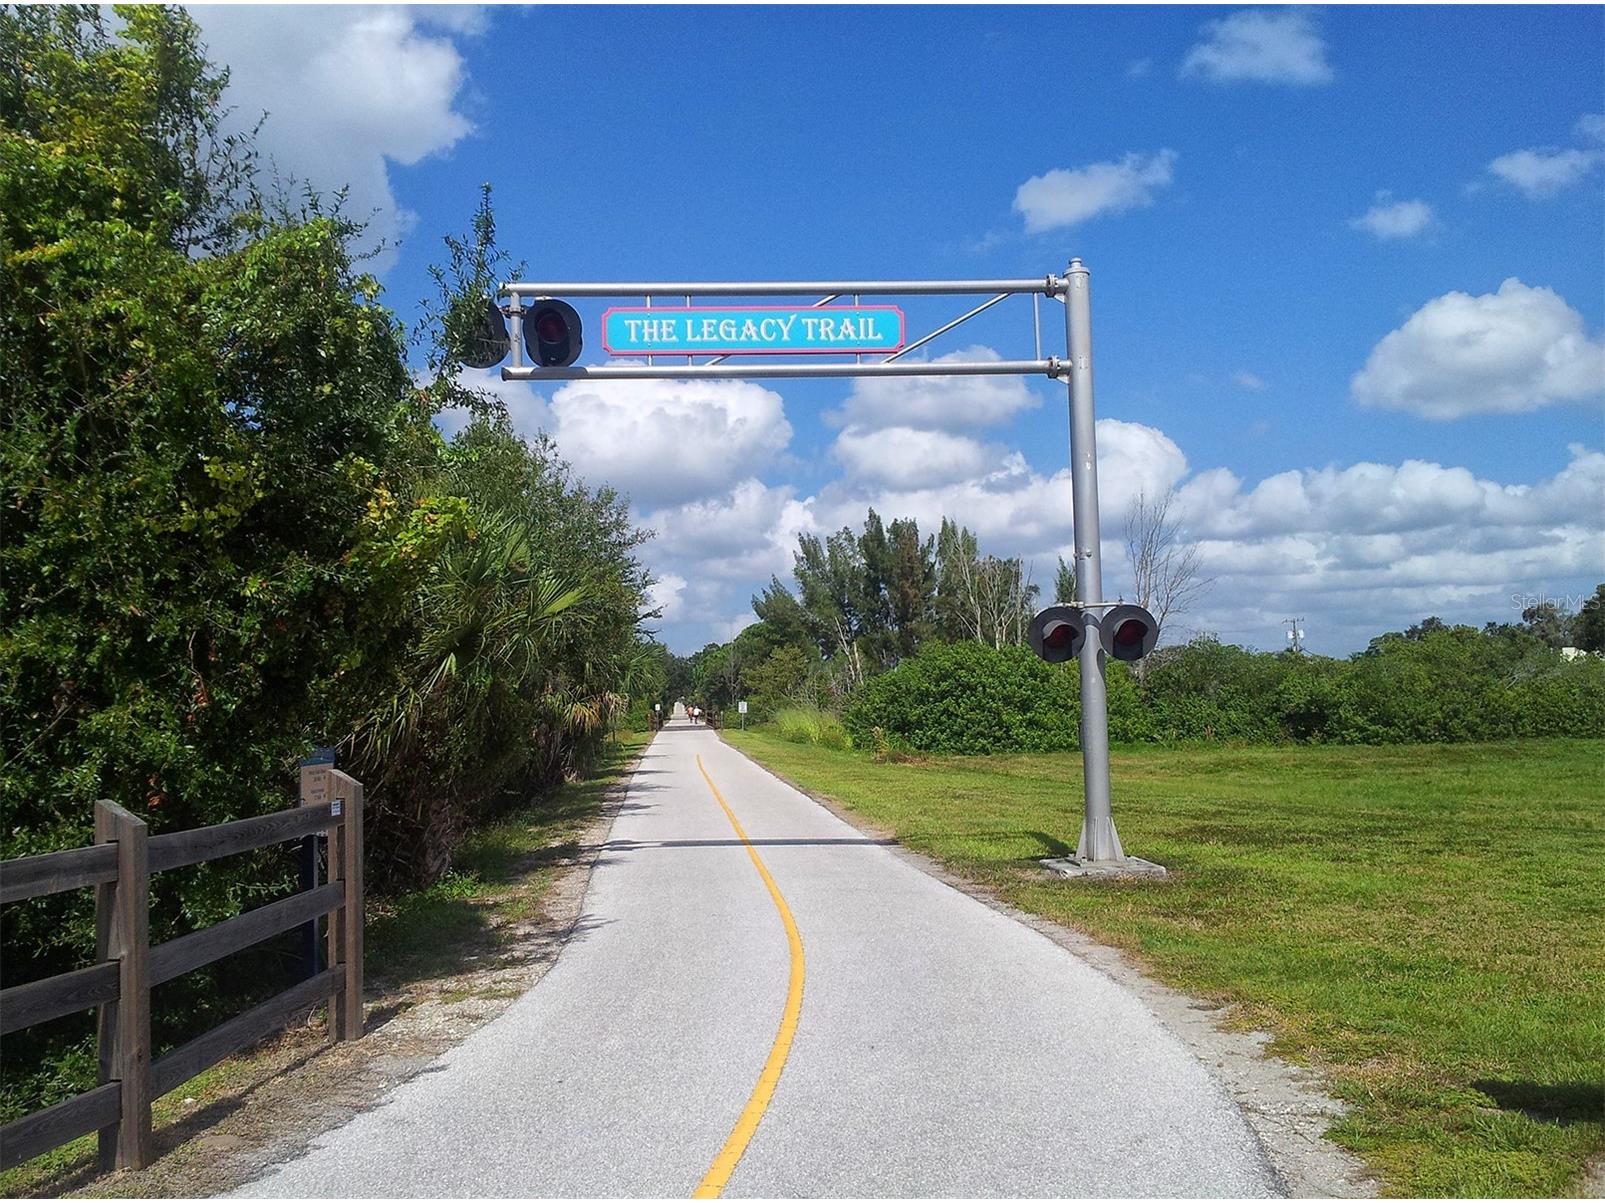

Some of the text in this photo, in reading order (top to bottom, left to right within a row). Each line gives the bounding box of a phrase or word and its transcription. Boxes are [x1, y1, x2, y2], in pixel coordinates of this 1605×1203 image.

[624, 314, 883, 343] THE LEGACY TRAIL
